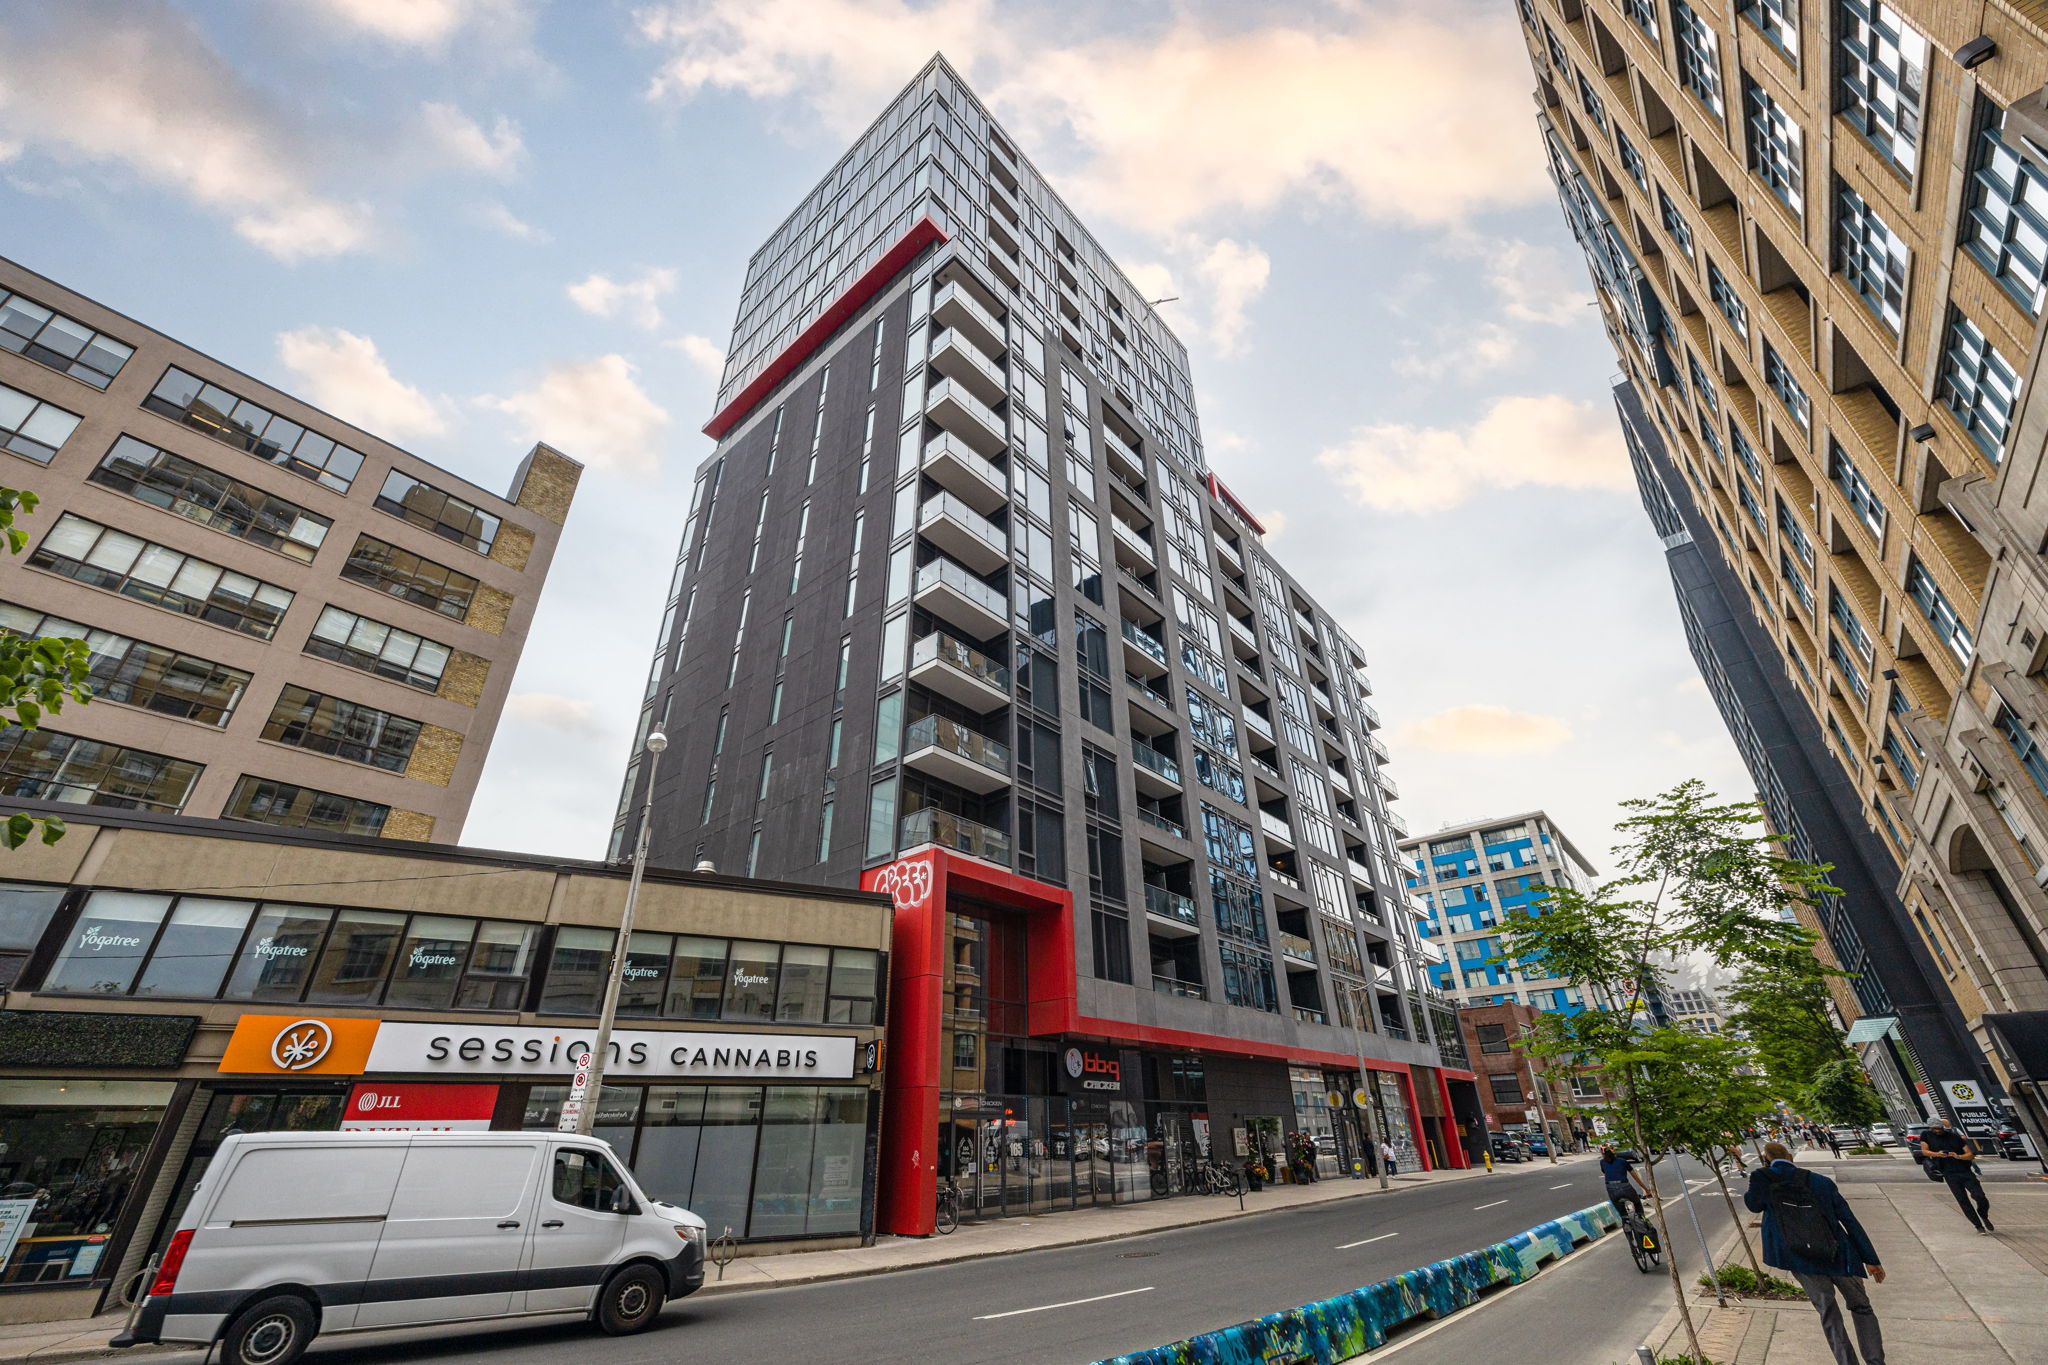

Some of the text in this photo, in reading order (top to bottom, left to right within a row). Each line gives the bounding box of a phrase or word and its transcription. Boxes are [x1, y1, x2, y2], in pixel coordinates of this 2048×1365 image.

[623, 967, 658, 981] ogatree
[670, 1046, 818, 1068] CANNABIS
[377, 1096, 401, 1108] JLL
